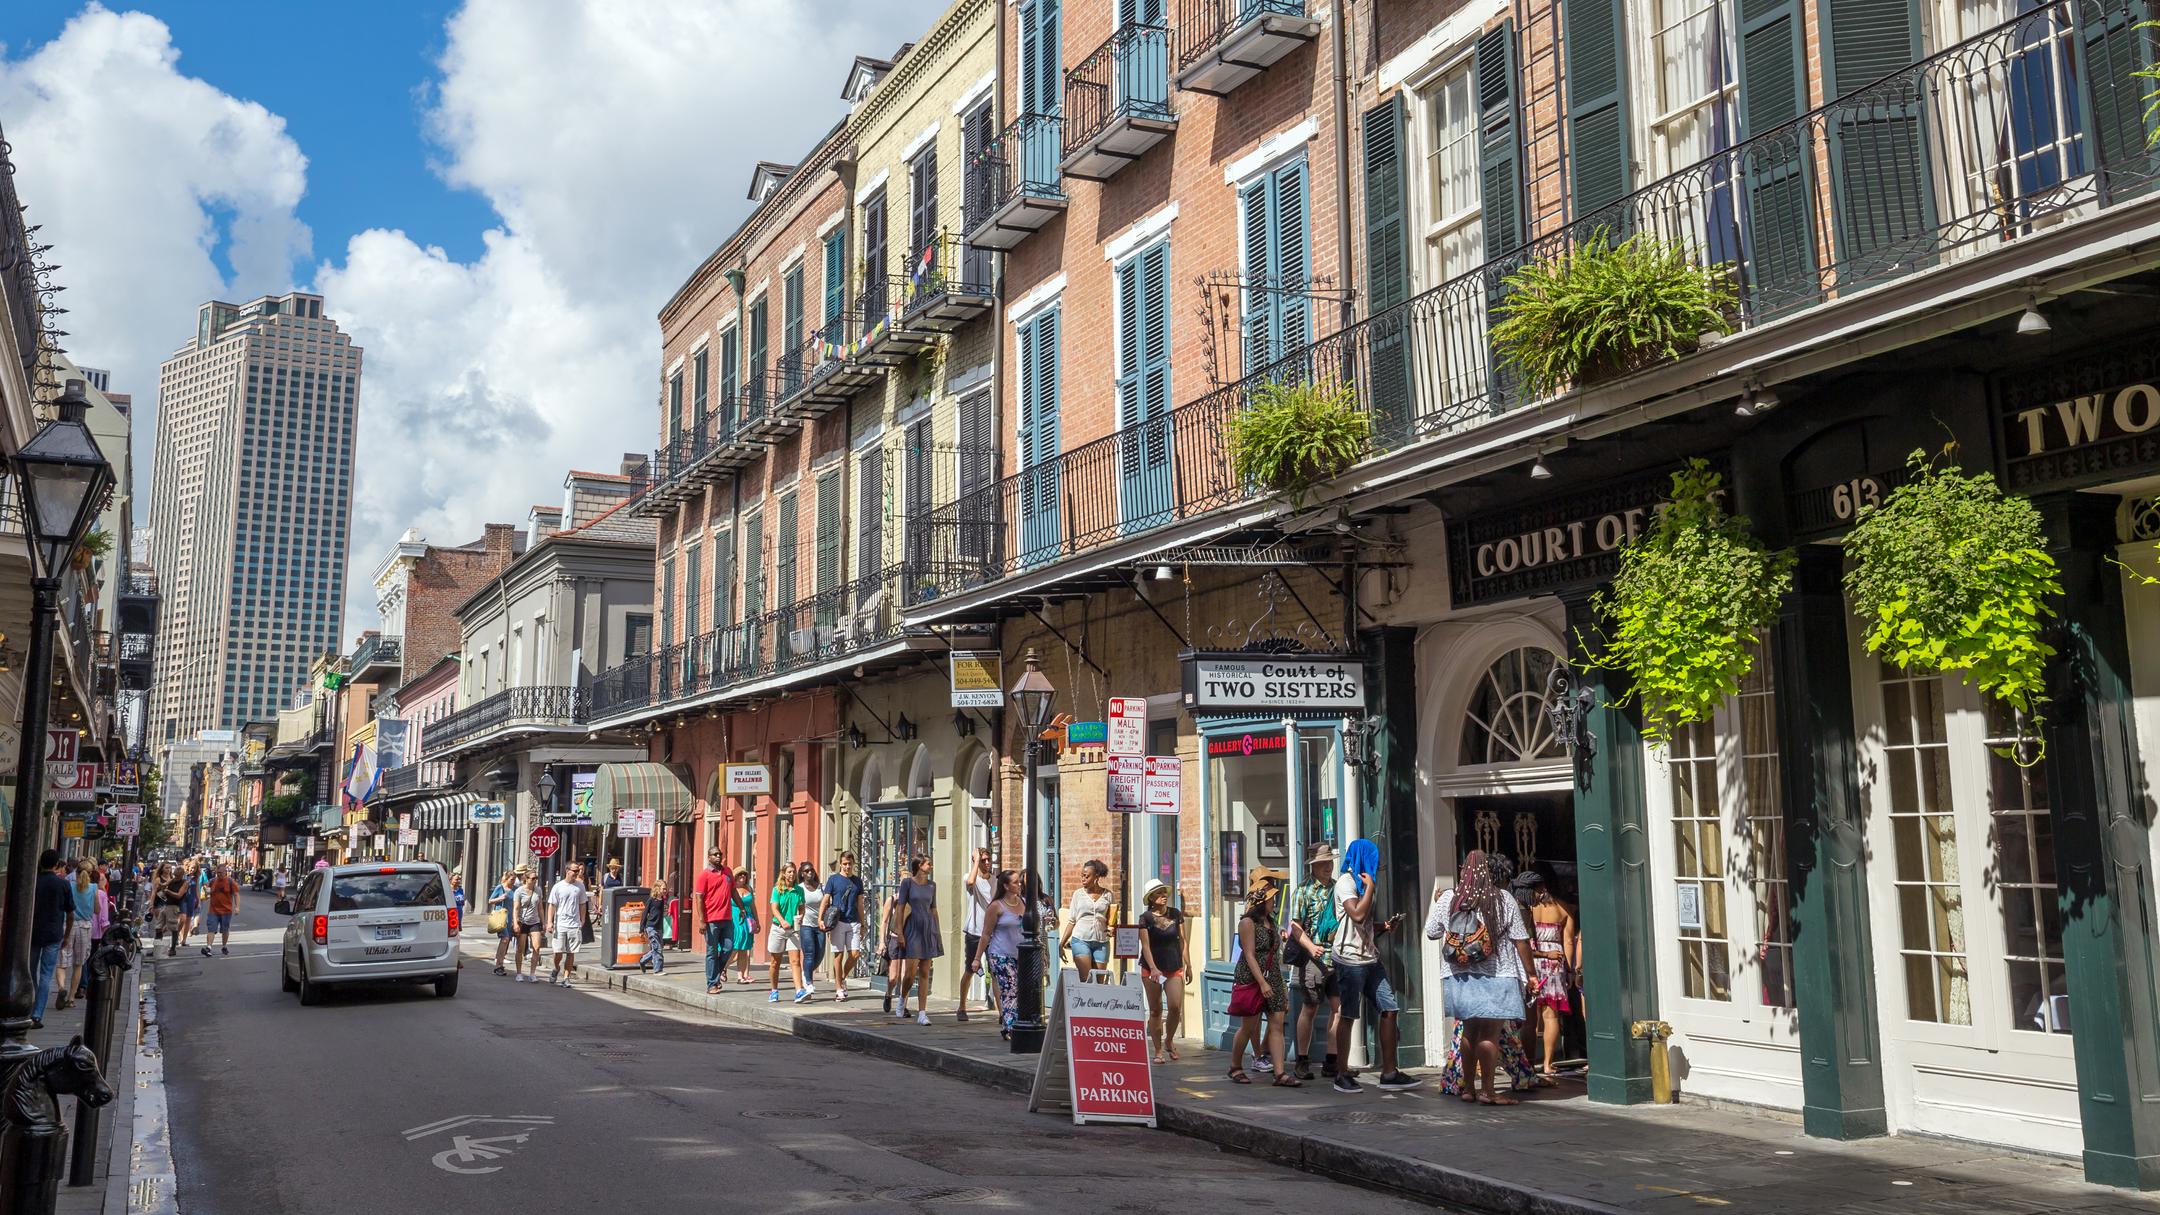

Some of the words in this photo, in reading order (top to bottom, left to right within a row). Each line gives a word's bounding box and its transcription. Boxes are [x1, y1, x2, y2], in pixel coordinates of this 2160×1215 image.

[2018, 384, 2160, 455] TWO
[1833, 478, 1880, 519] 613
[1477, 521, 1585, 577] COURT
[1596, 508, 1644, 551] OF
[1262, 664, 1317, 678] Court
[1326, 664, 1345, 682] of
[1205, 681, 1255, 698] TWO
[1264, 682, 1357, 699] SISTERS
[1111, 702, 1123, 713] NO
[1124, 705, 1144, 713] PARKING
[1117, 719, 1136, 728] MALL
[1208, 739, 1243, 754] GALLERY
[1253, 735, 1287, 750] RINARD
[46, 763, 74, 775] YALE
[1108, 760, 1119, 771] NO
[1119, 762, 1142, 770] PARKING
[1146, 760, 1156, 772] NO
[1156, 762, 1180, 770] PARKING
[1110, 776, 1140, 784] FREIGHT
[1146, 780, 1179, 788] PASSENGER
[1115, 785, 1134, 793] ZONE
[530, 836, 558, 848] STOP
[423, 910, 446, 921] 0788
[365, 946, 389, 955] White
[391, 945, 412, 954] Fleet
[1072, 996, 1086, 1009] The
[1087, 998, 1102, 1008] Court
[1103, 1000, 1110, 1009] of
[1109, 998, 1123, 1010] Two
[1073, 1025, 1144, 1040] PASSENGER
[1094, 1041, 1127, 1054] ZONE
[1101, 1071, 1125, 1086] NO
[1080, 1087, 1149, 1104] PARKING
